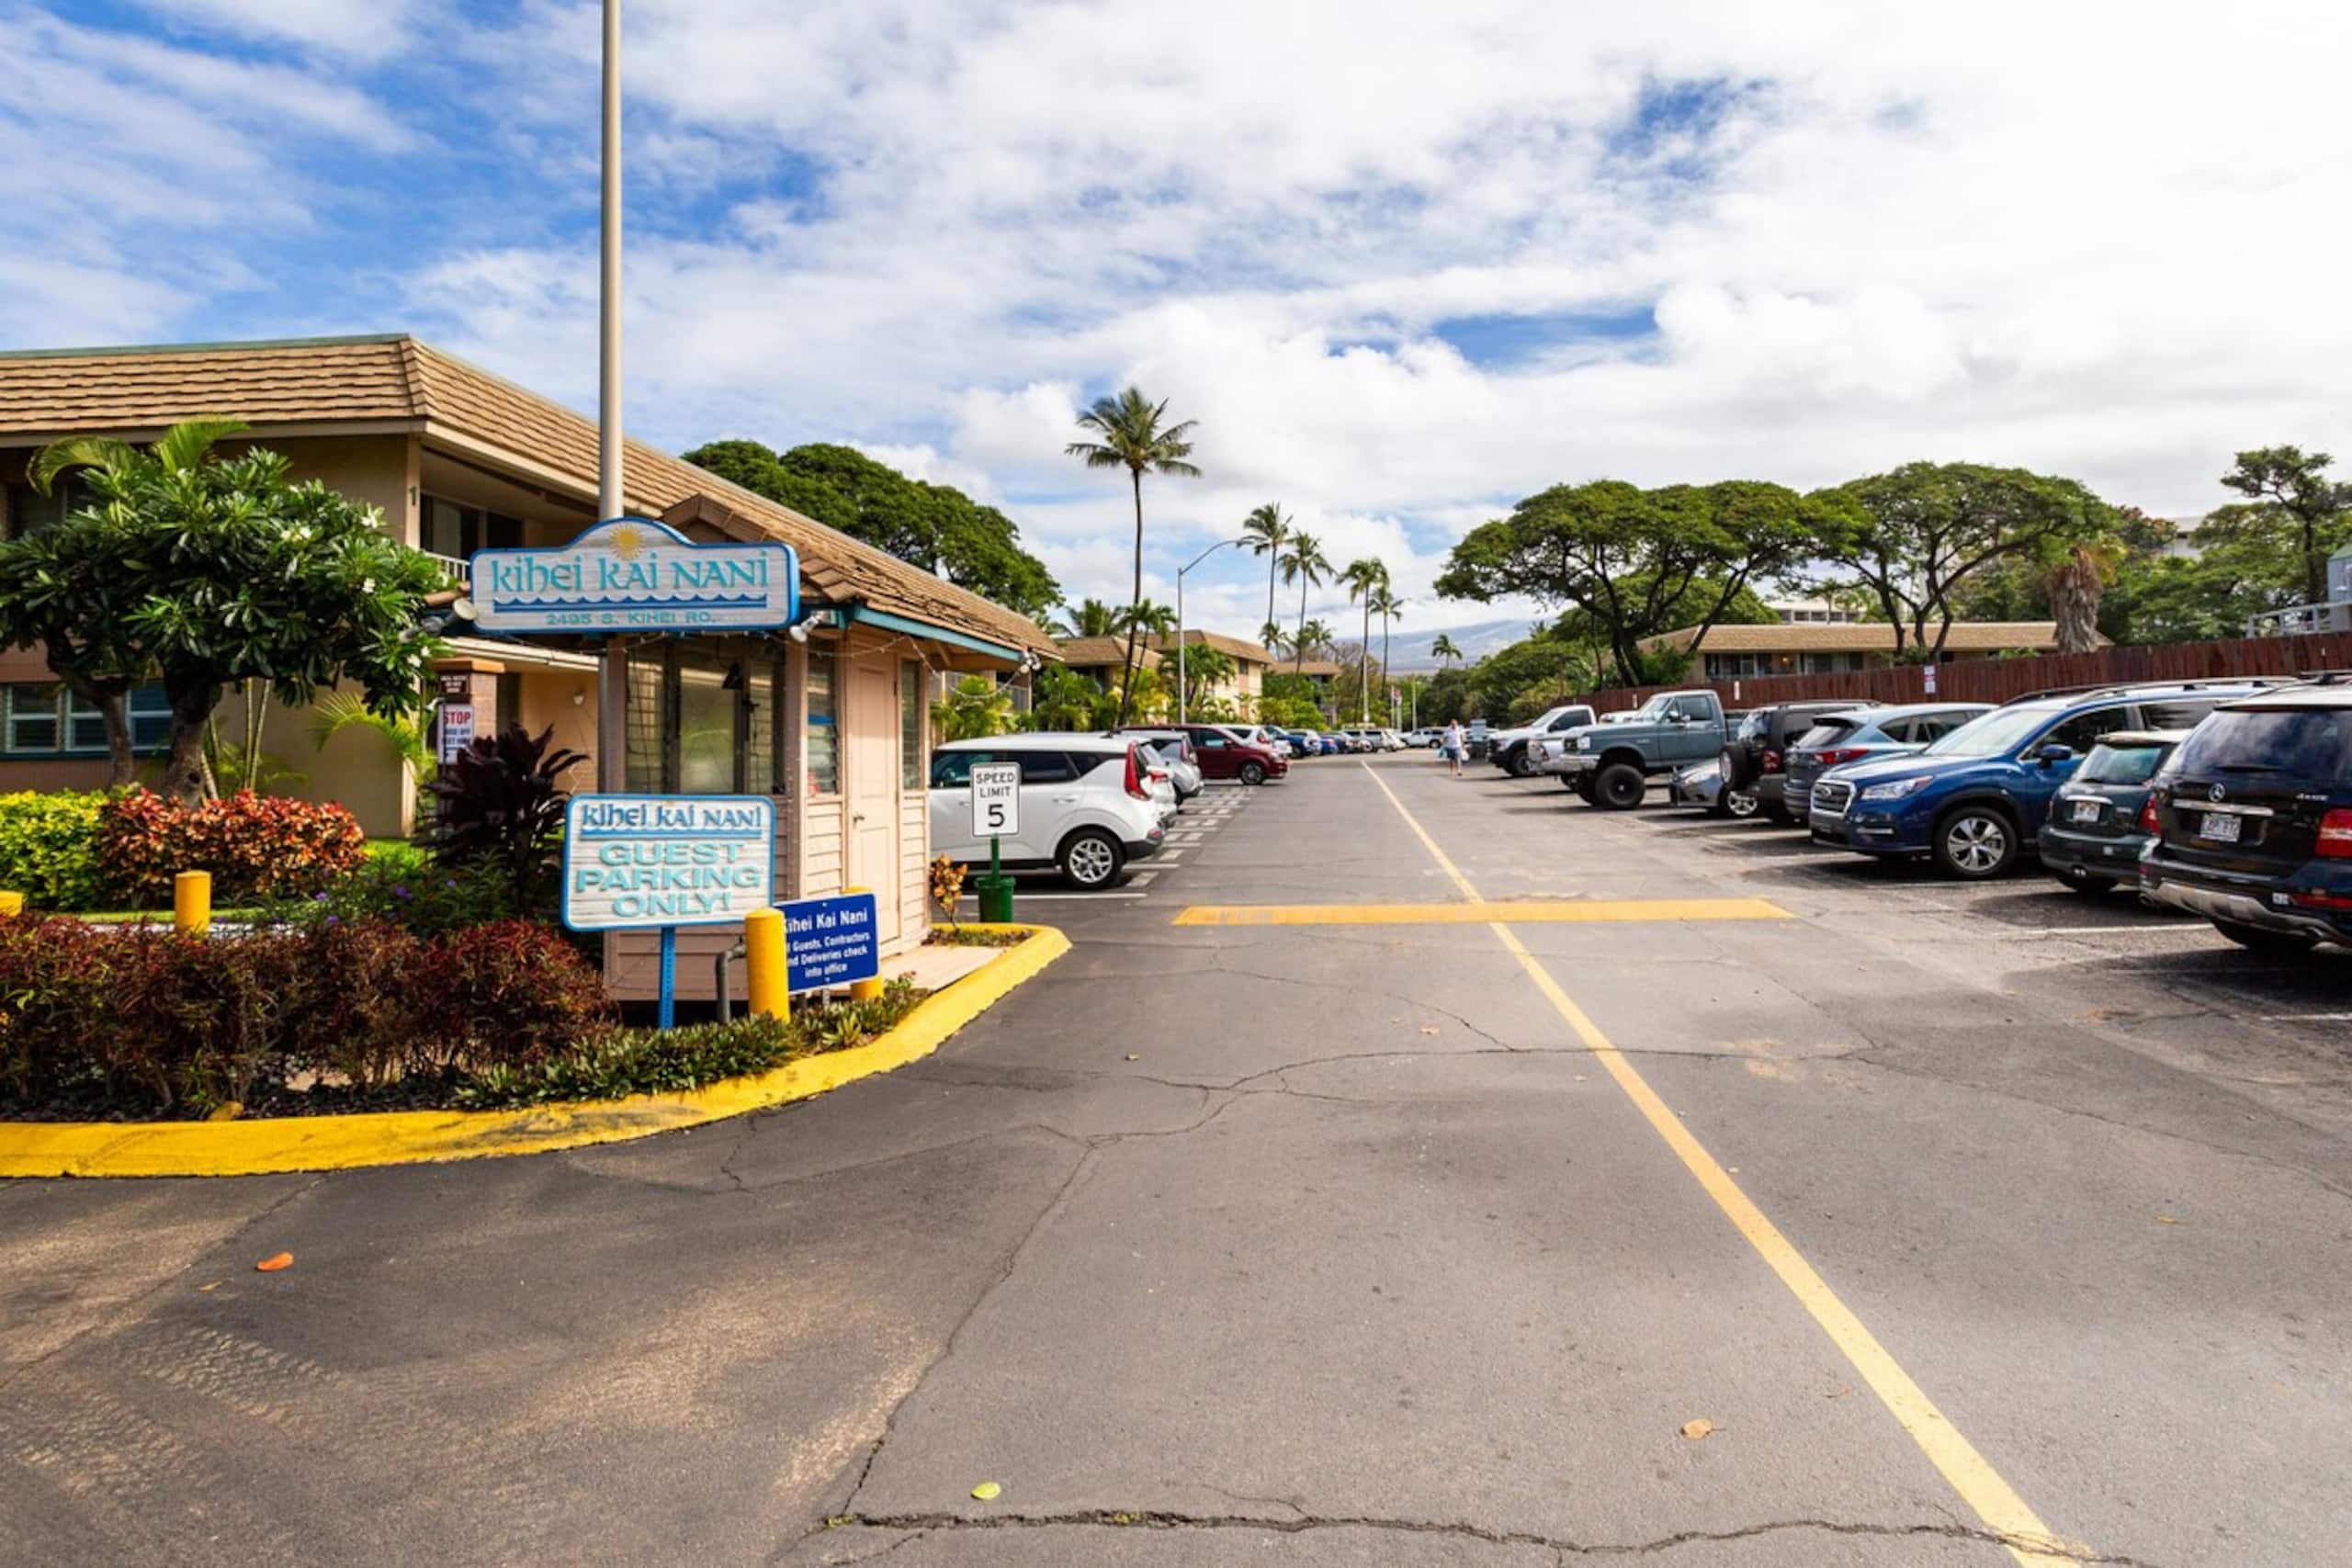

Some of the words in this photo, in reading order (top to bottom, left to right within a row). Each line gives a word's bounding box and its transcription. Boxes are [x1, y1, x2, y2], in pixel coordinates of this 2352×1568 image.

[547, 613, 593, 626] 2495
[628, 610, 676, 624] KIHEI
[445, 711, 471, 725] STOP
[976, 773, 1016, 784] SPEED
[979, 786, 1012, 798] LIMIT
[988, 804, 1005, 828] 5
[599, 840, 744, 866] GUEST
[575, 865, 761, 893] PARKING
[612, 891, 733, 917] ONLY!
[816, 912, 836, 930] Kai
[840, 907, 868, 927] Nani
[824, 931, 871, 948] Contractors
[787, 955, 799, 967] nd
[800, 950, 842, 965] Deliveries
[843, 943, 868, 958] check
[824, 962, 848, 976] office
